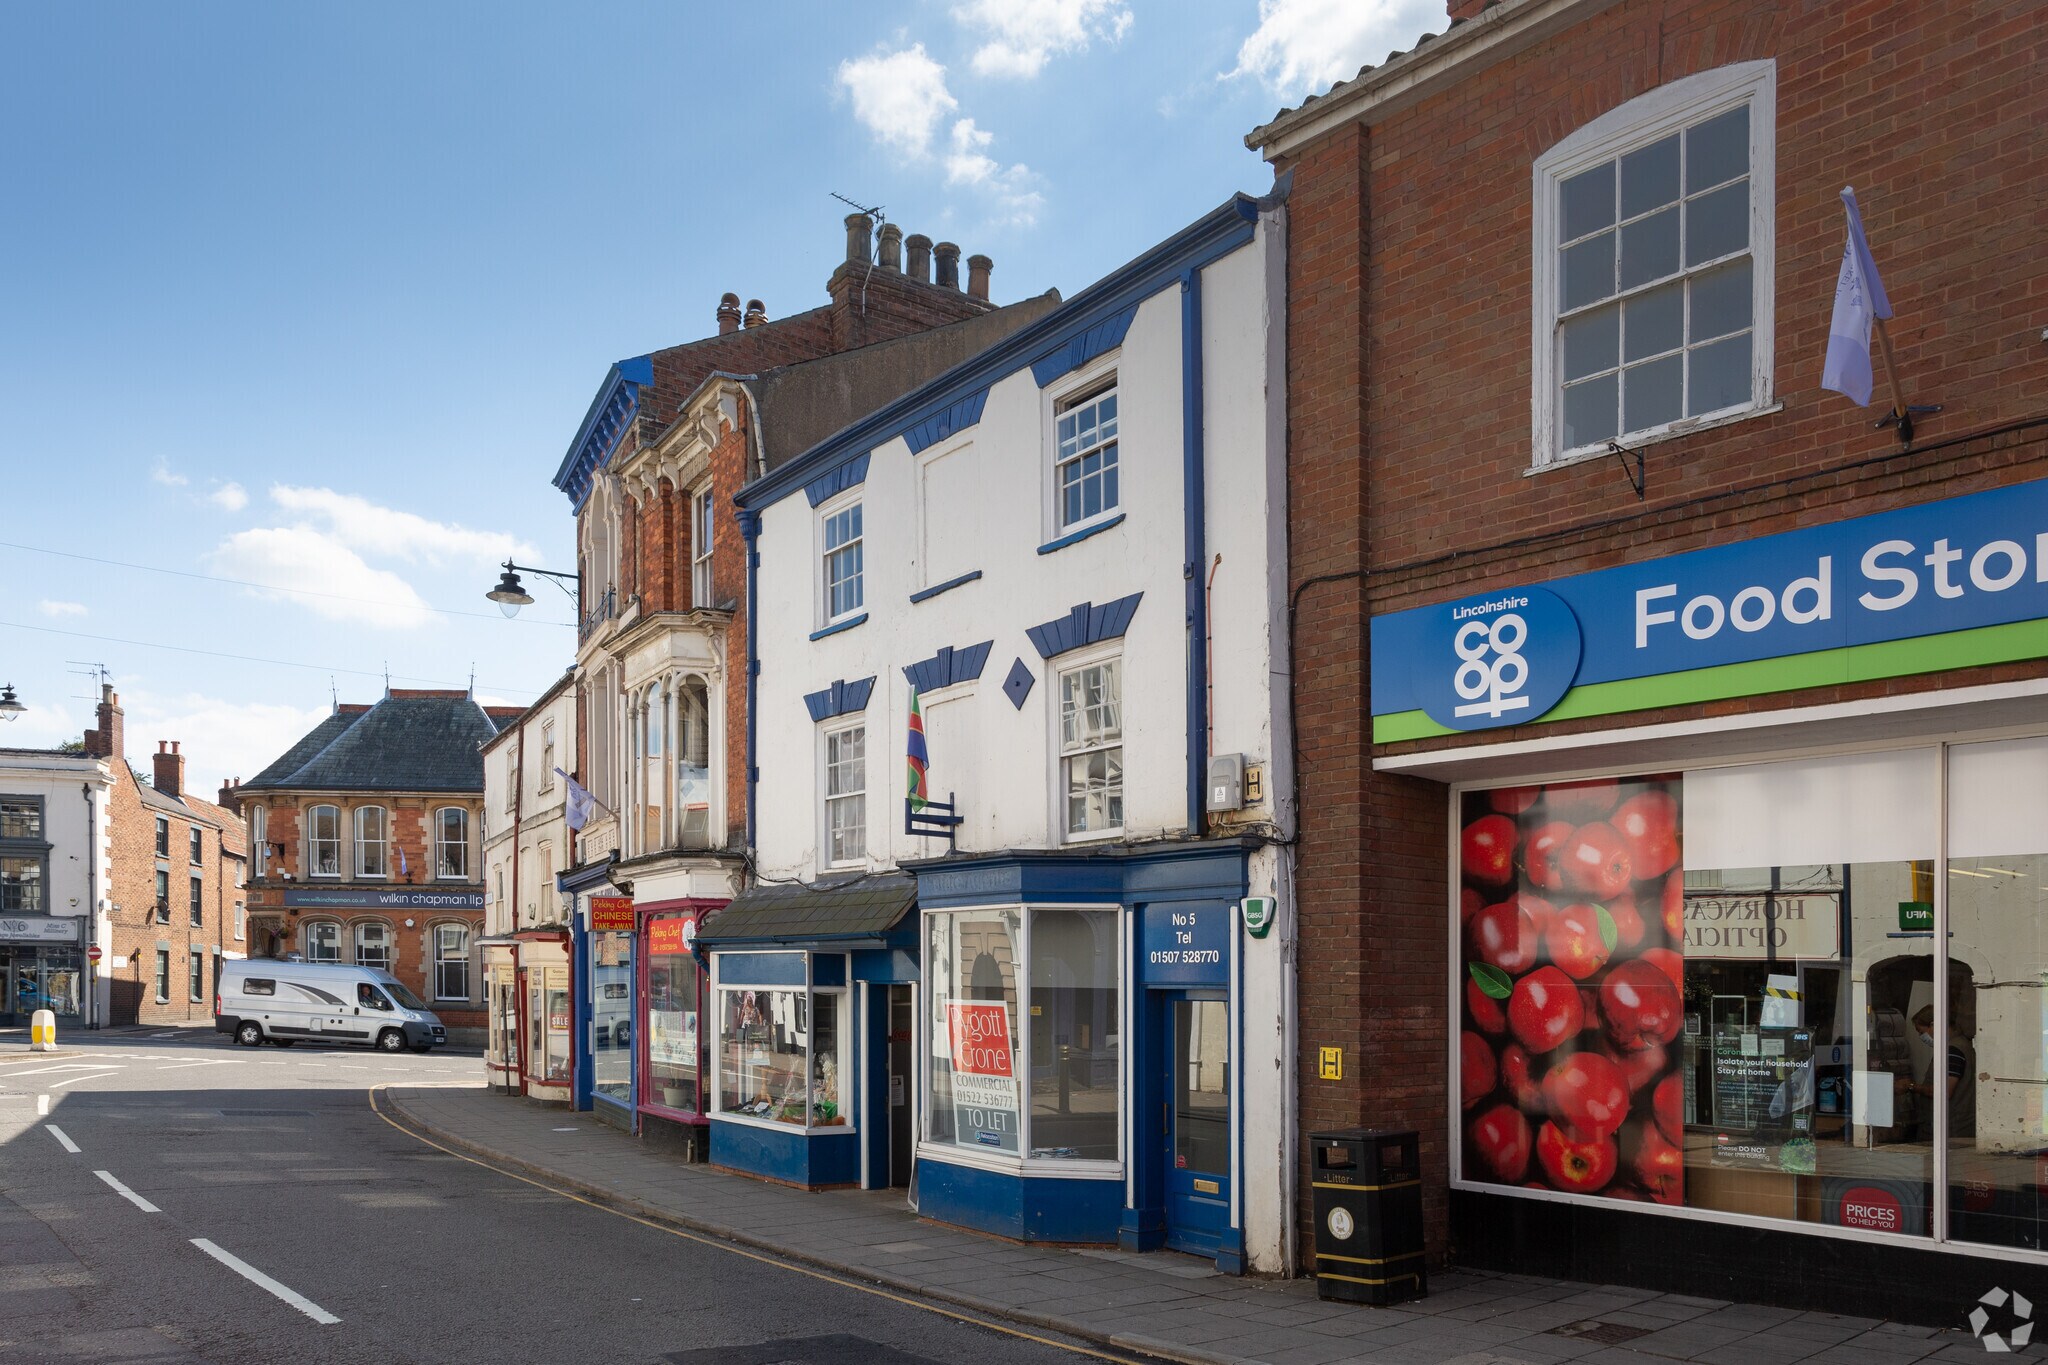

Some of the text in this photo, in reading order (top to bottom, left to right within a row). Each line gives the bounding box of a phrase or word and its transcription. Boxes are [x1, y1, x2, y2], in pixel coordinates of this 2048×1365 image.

[1453, 596, 1529, 620] Lincolnshire
[1635, 555, 1832, 649] Food
[379, 893, 409, 904] wilkin
[411, 893, 467, 907] chapman
[469, 894, 484, 907] llp
[592, 899, 615, 911] Peking
[593, 911, 634, 921] CHINESE
[1172, 912, 1196, 926] No 5
[594, 922, 634, 930] TAKE-AWAY
[651, 922, 681, 941] Peking Chef
[1175, 931, 1192, 944] Tel
[1150, 950, 1219, 964] 01507 528770
[551, 1016, 569, 1026] SALE
[950, 1007, 1003, 1042] Pygott
[961, 1041, 1007, 1071] Crone
[1717, 1057, 1745, 1066] Isolate
[1765, 1058, 1809, 1068] household
[1717, 1066, 1736, 1076] Stay
[1747, 1068, 1771, 1076] home
[956, 1074, 1013, 1093] COMMERCIAL
[957, 1089, 1013, 1109] 01522 536777
[965, 1107, 1007, 1132] TO LET
[1717, 1144, 1738, 1152] Please
[1746, 1153, 1770, 1162] building
[1326, 1173, 1350, 1184] Litter
[1846, 1203, 1896, 1221] PRICES
[1846, 1216, 1895, 1229] TO HELP YOU
